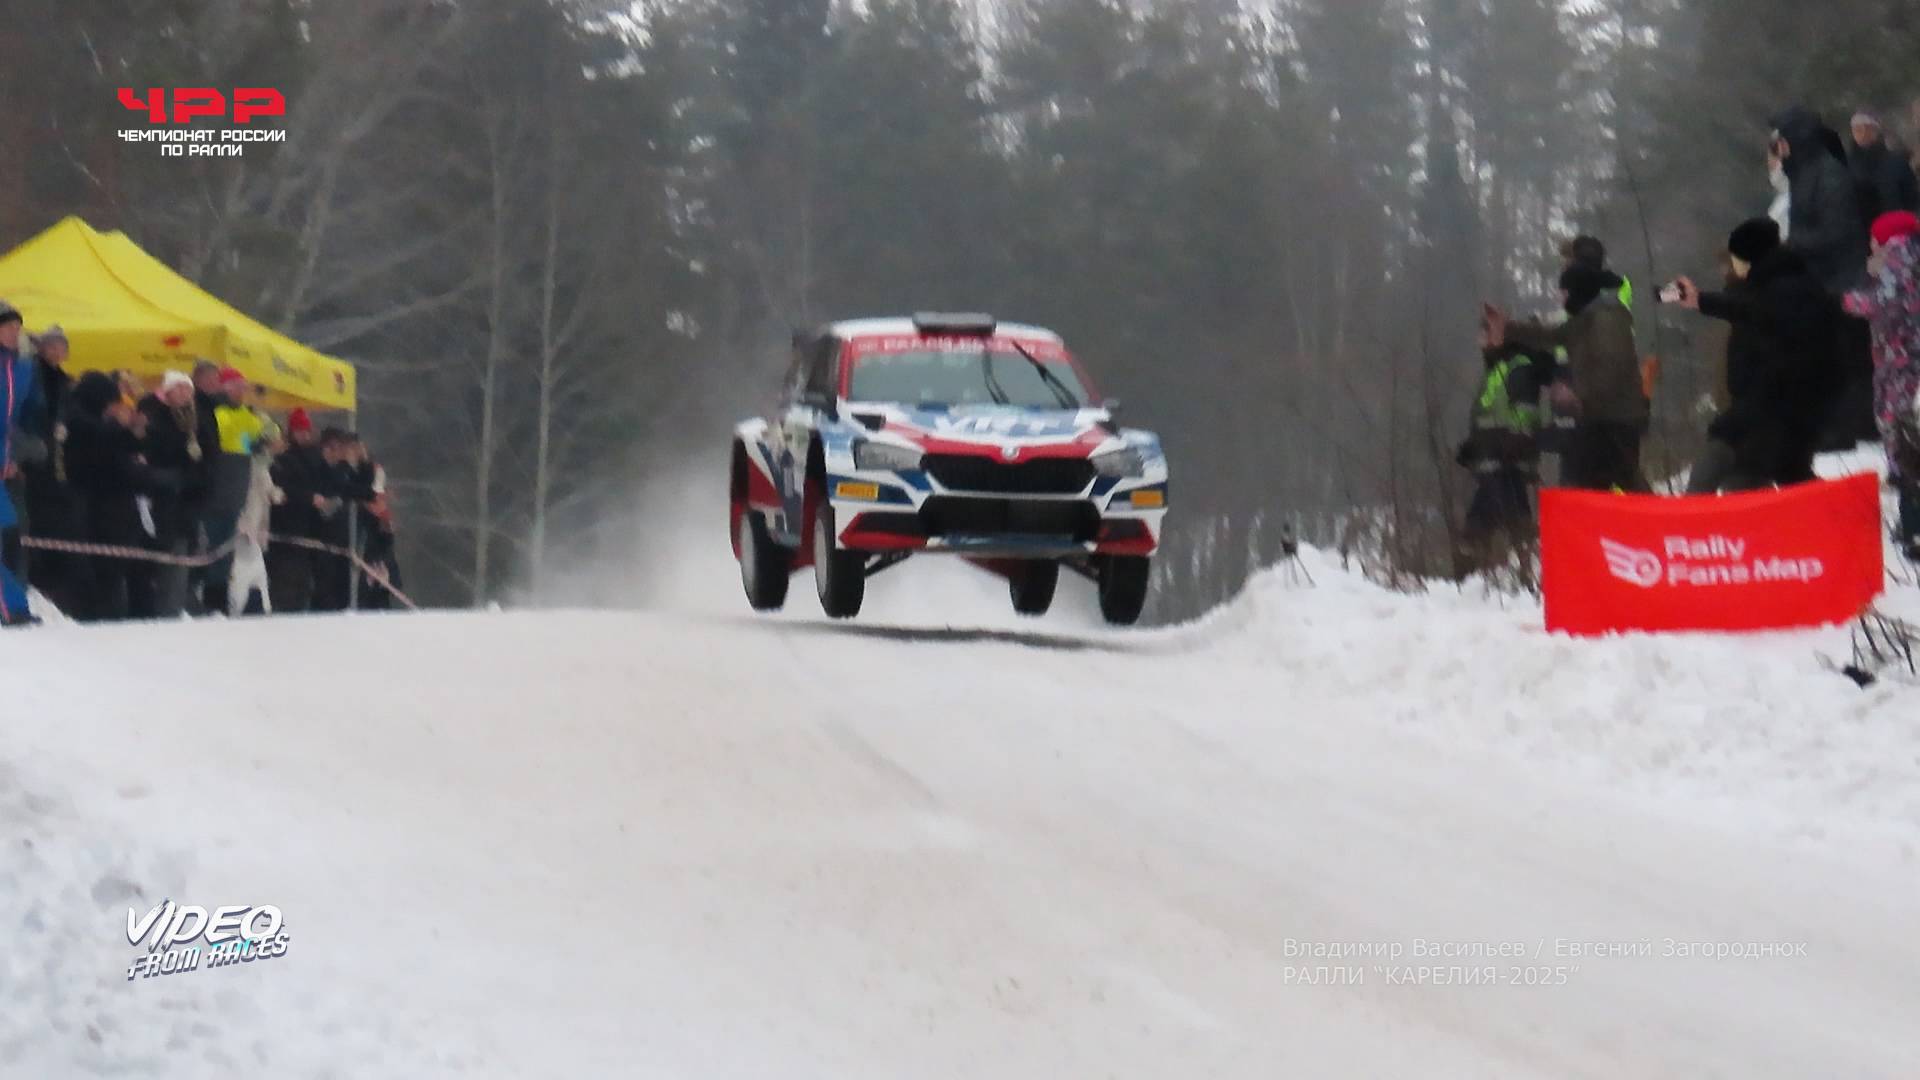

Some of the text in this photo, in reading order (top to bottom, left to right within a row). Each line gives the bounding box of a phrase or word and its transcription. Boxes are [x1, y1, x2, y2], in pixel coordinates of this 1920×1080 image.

[1664, 535, 1745, 560] Rally
[1668, 556, 1823, 587] Fans Map
